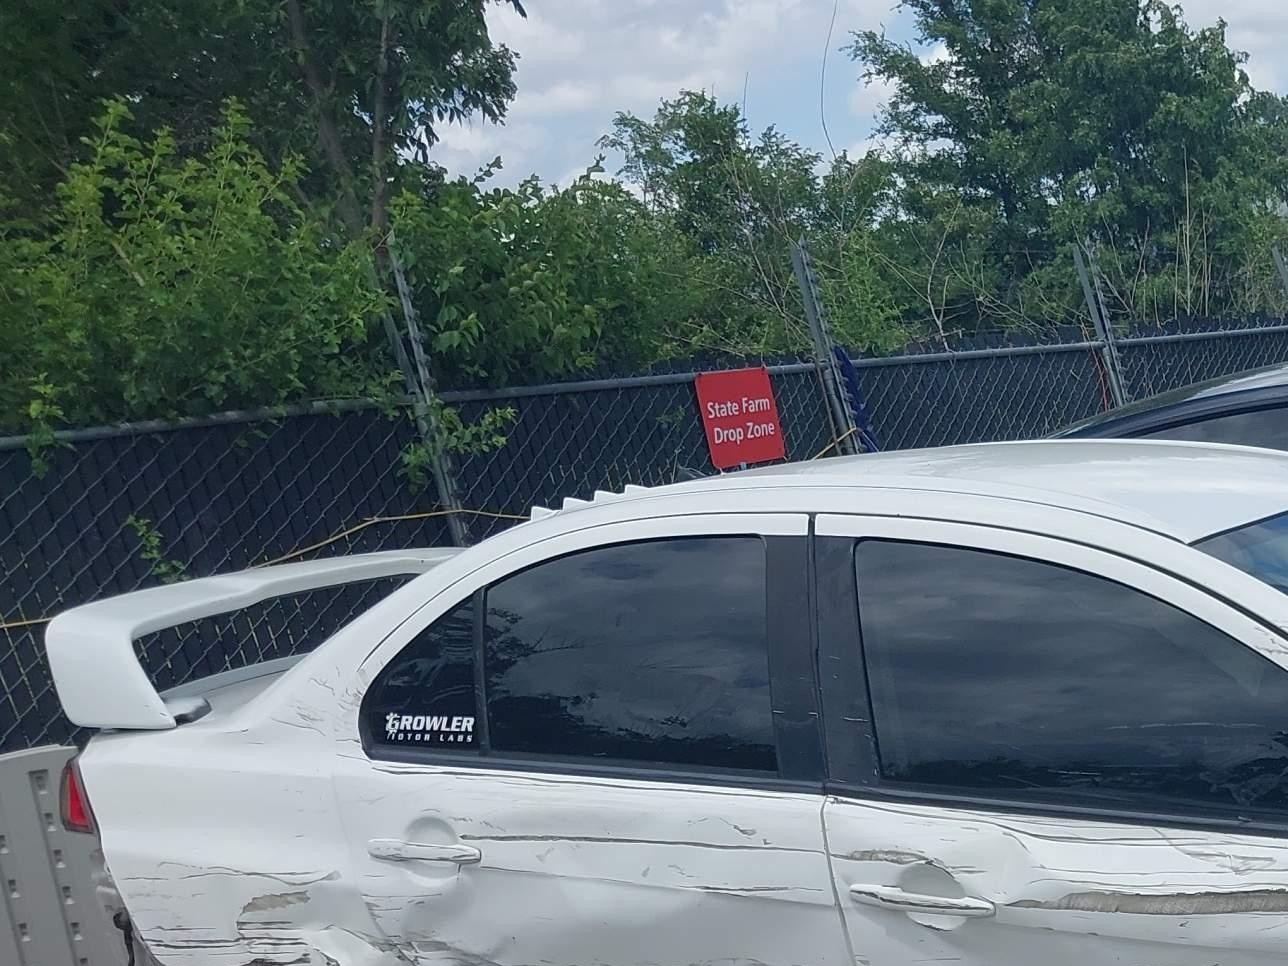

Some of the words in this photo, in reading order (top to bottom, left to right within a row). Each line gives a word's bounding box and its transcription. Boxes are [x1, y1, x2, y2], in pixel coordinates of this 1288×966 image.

[707, 401, 740, 418] State
[742, 397, 770, 413] Farm
[714, 427, 744, 445] Drop
[746, 422, 775, 439] Zone
[386, 713, 475, 732] GROWLER
[439, 734, 473, 743] LABS
